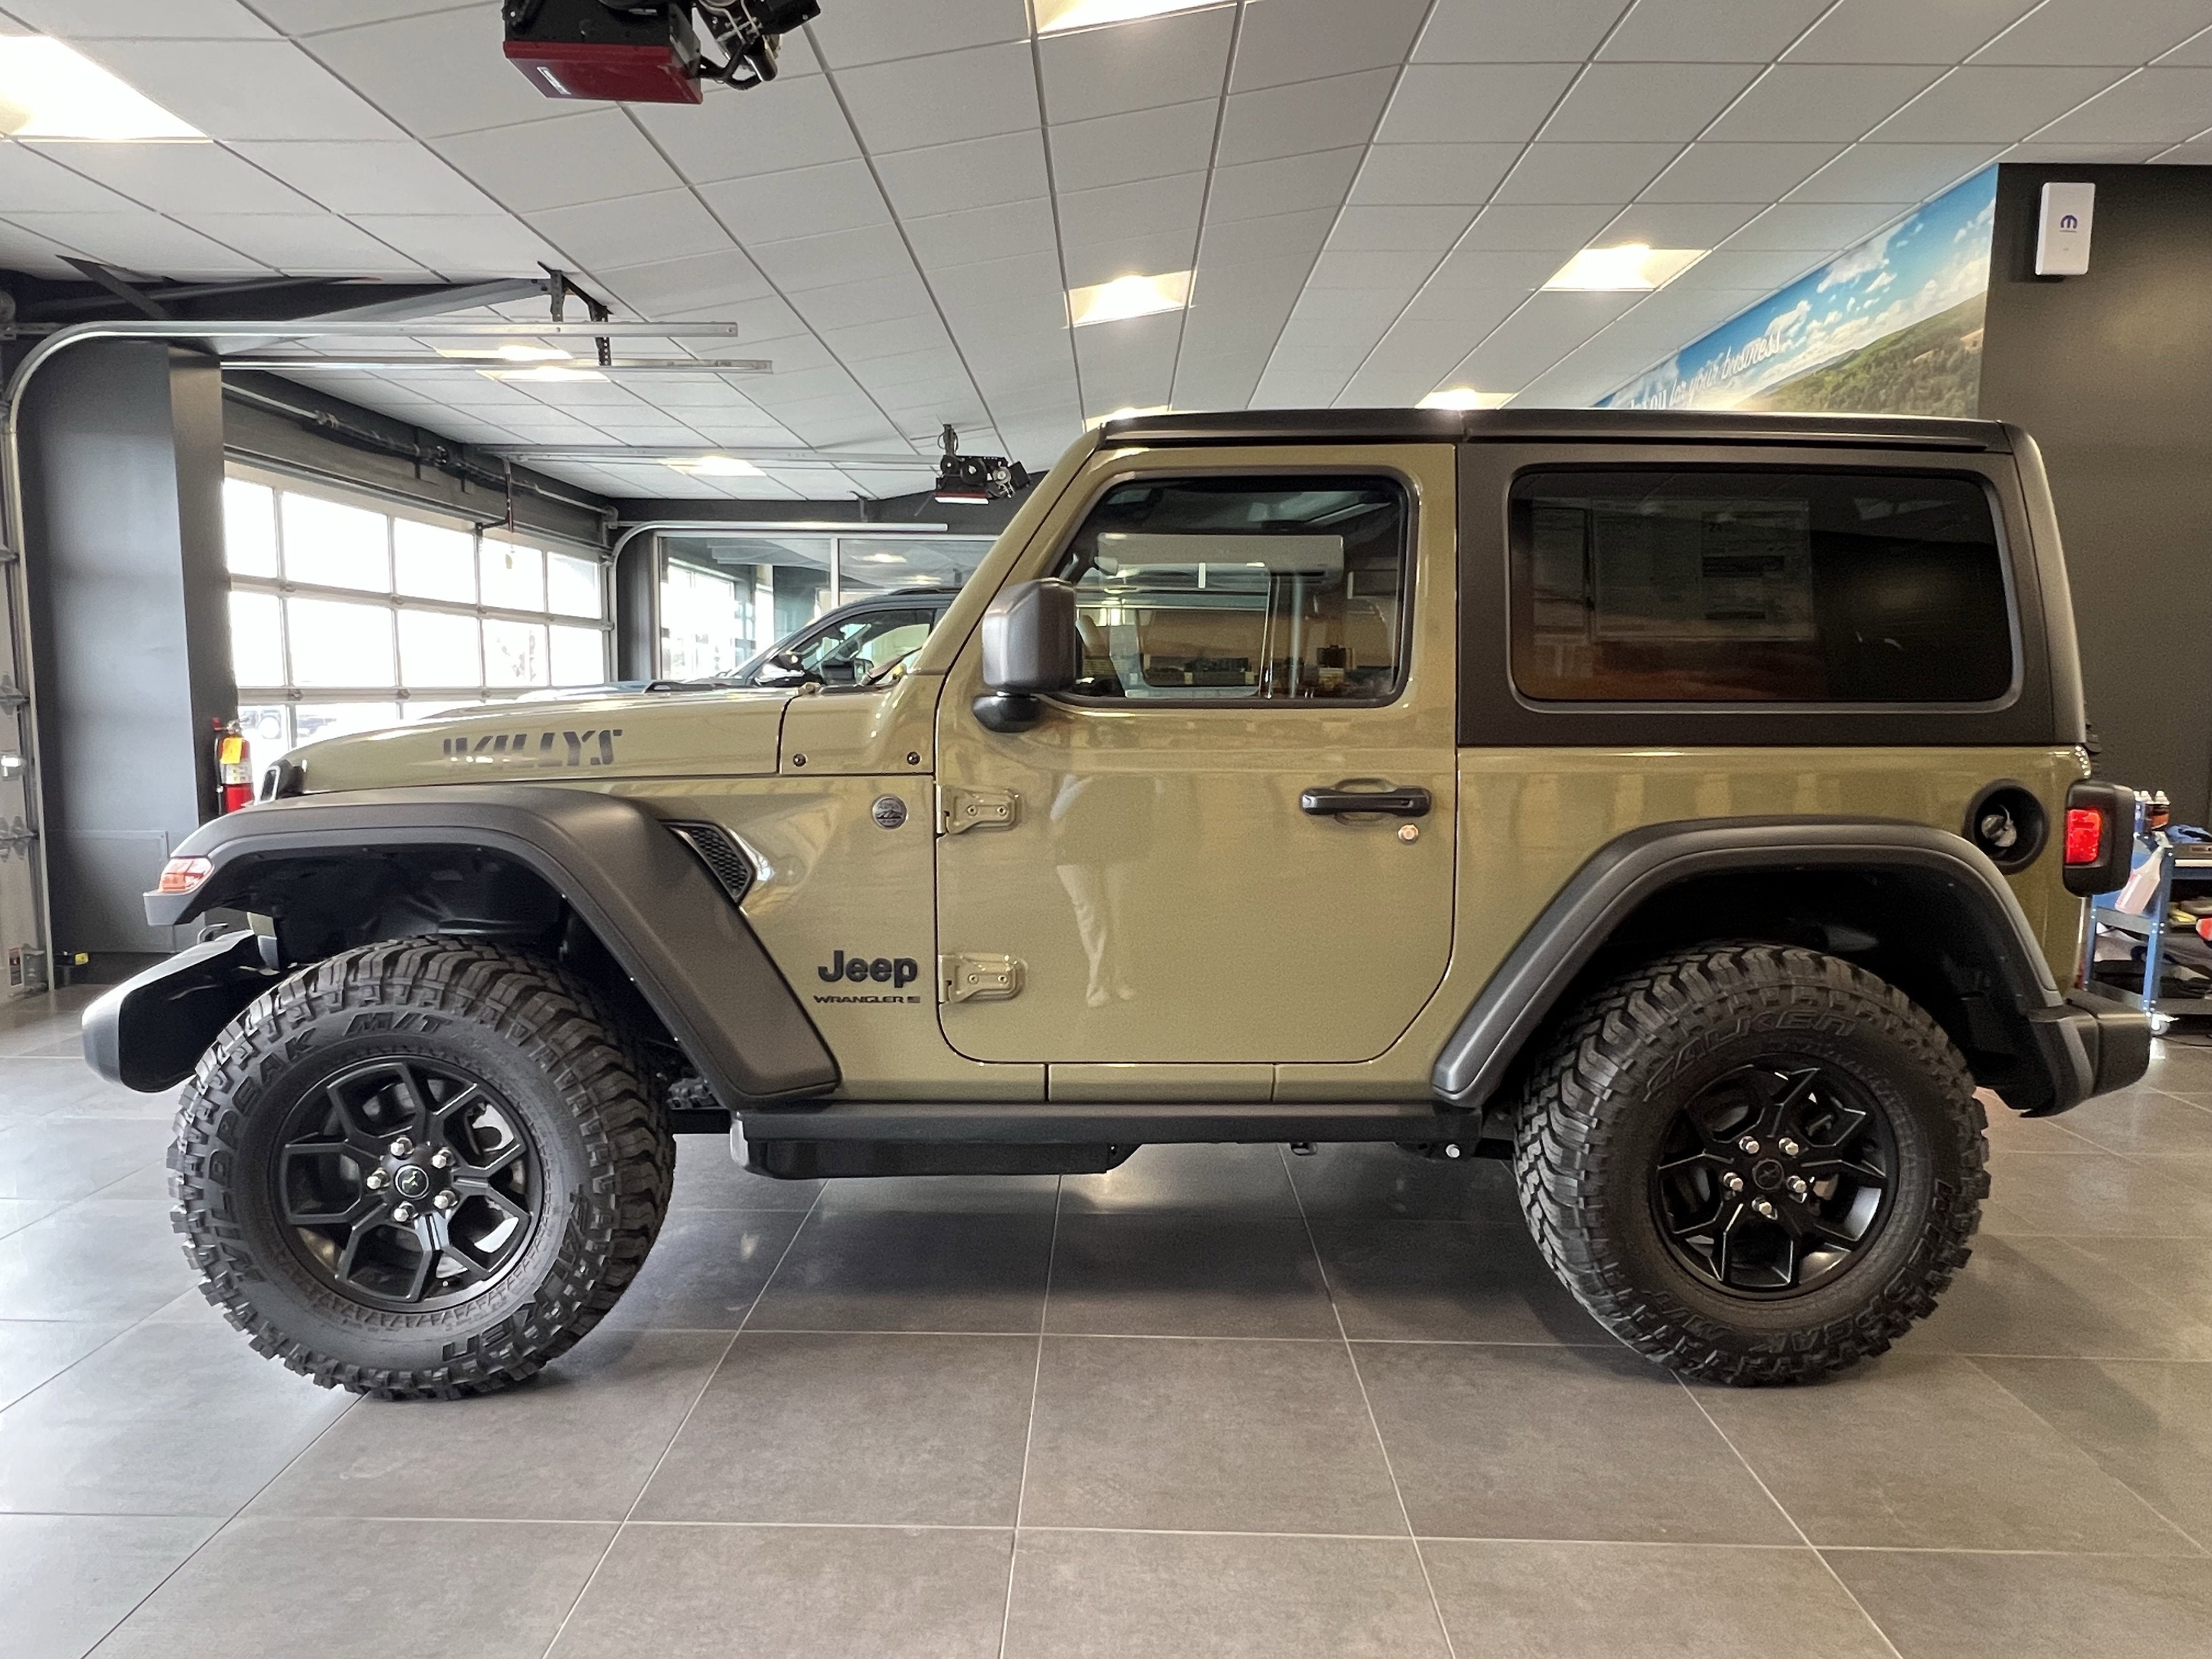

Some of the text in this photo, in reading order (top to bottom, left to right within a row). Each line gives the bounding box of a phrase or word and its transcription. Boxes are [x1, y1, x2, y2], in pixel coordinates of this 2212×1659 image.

[443, 729, 623, 768] WILLYS
[817, 949, 918, 988] Jeep
[813, 995, 904, 1004] WRANGLER
[207, 1012, 453, 1283] WILDPEAK M/T
